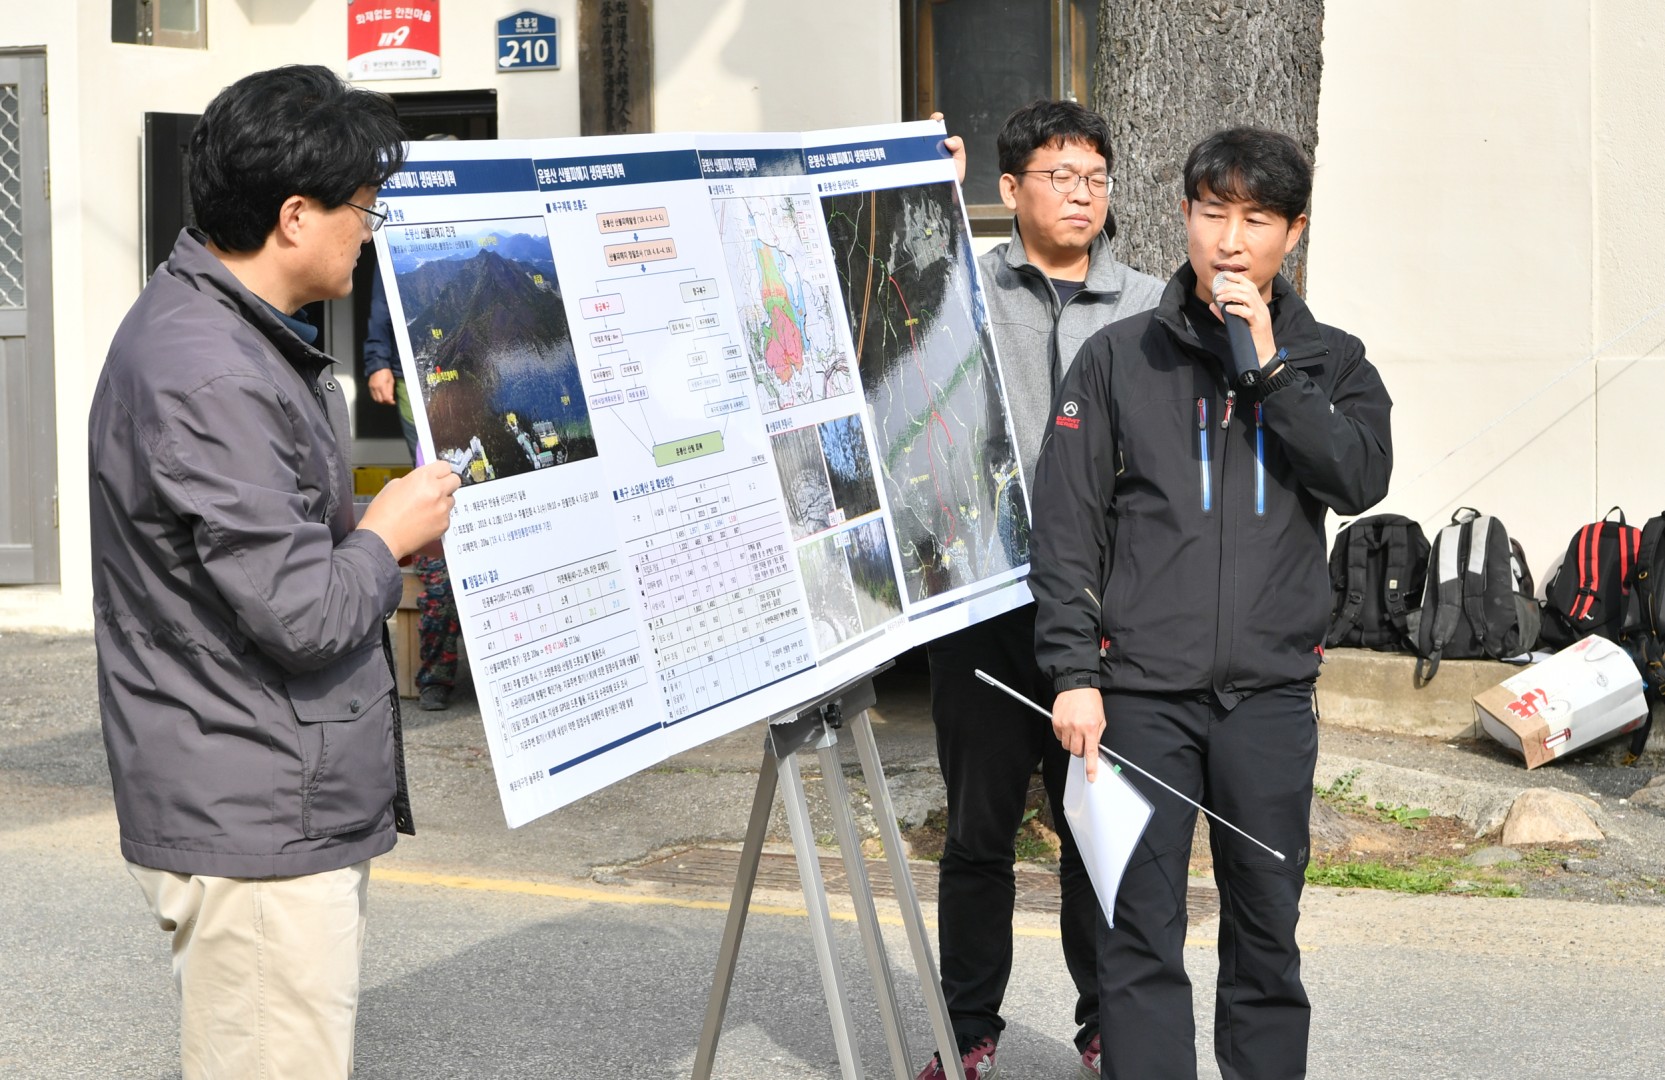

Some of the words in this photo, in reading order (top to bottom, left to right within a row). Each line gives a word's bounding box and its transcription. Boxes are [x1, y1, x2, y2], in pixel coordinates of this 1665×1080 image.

[356, 9, 392, 24] 화재없는
[395, 7, 432, 22] 안전마을
[516, 17, 538, 28] 운봉길
[377, 26, 410, 46] 119
[505, 39, 549, 63] 210
[701, 158, 714, 172] 운봉산
[714, 157, 734, 172] 산불피해지
[734, 157, 758, 172] 생태복원계획
[808, 154, 826, 168] 운봉산
[826, 151, 854, 166] 산불피해지
[854, 147, 886, 163] 생태복원계획
[388, 171, 419, 189] 산불피해지
[419, 170, 456, 188] 생태복원계획
[537, 168, 557, 185] 운봉산
[558, 166, 589, 183] 산불피해지
[589, 162, 626, 180] 생태복원계획
[823, 181, 837, 192] 운봉산
[838, 179, 860, 190] 등산안내도
[552, 200, 572, 213] 복구계획
[573, 198, 587, 210] 흐름도
[619, 486, 629, 498] 복구
[630, 481, 649, 496] 소요예산
[650, 480, 655, 491] 및
[655, 475, 675, 489] 확보방안
[468, 572, 488, 588] 정밀조사
[488, 569, 499, 582] 결과
